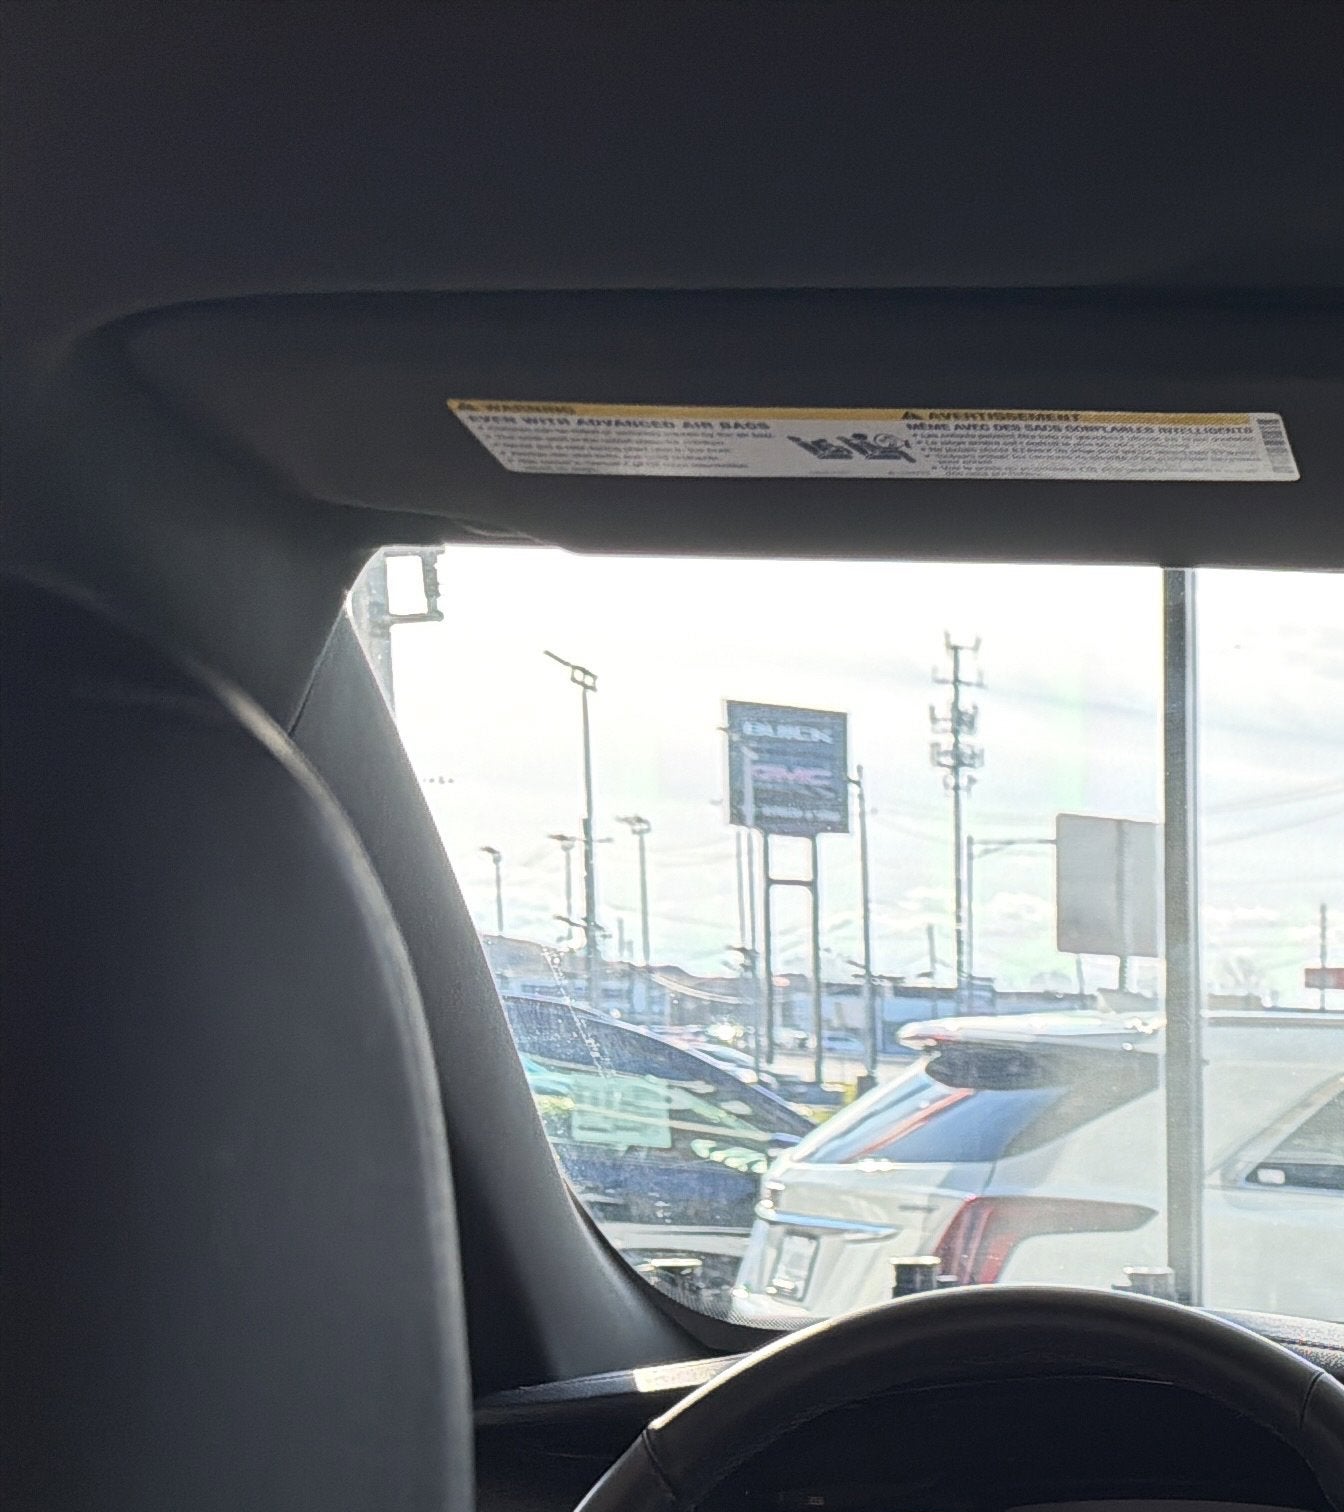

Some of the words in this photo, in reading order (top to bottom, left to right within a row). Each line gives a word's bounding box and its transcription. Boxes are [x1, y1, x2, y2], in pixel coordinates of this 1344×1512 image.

[468, 415, 517, 424] EVEN
[525, 417, 570, 426] WITH
[577, 418, 675, 429] ADVANCED
[683, 421, 714, 430] AIR
[719, 422, 770, 431] BAGS
[929, 411, 1081, 422] AVERTISSEMENT
